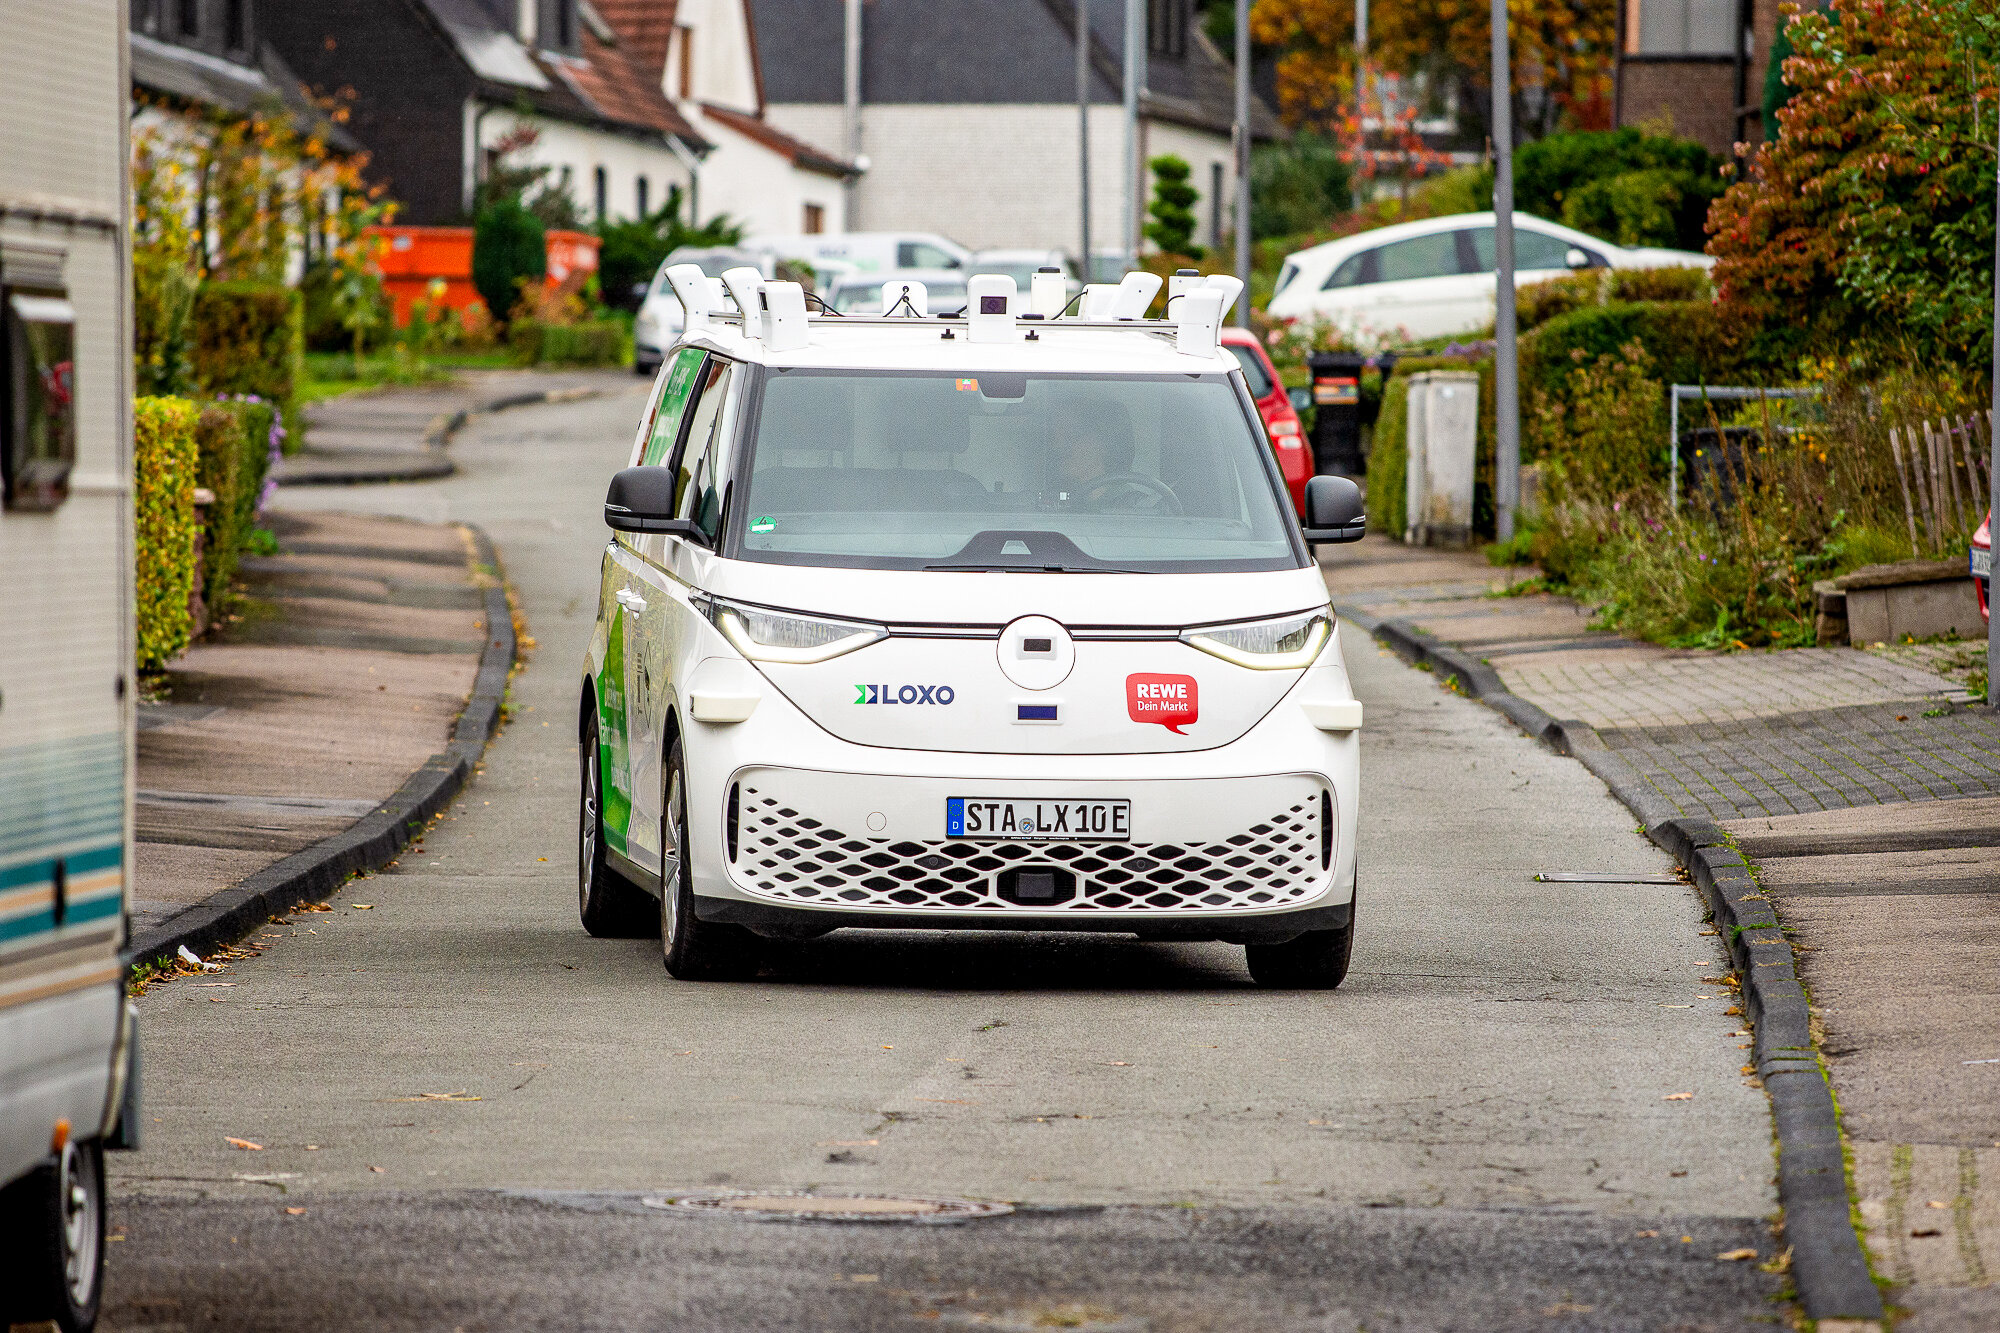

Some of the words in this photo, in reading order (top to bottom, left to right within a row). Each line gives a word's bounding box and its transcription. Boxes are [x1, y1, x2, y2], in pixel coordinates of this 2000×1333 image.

[882, 684, 955, 705] LOXO
[1136, 683, 1188, 699] REWE
[1137, 701, 1158, 711] Dein
[1160, 701, 1188, 712] Markt
[952, 821, 960, 830] D
[966, 803, 1017, 832] STA
